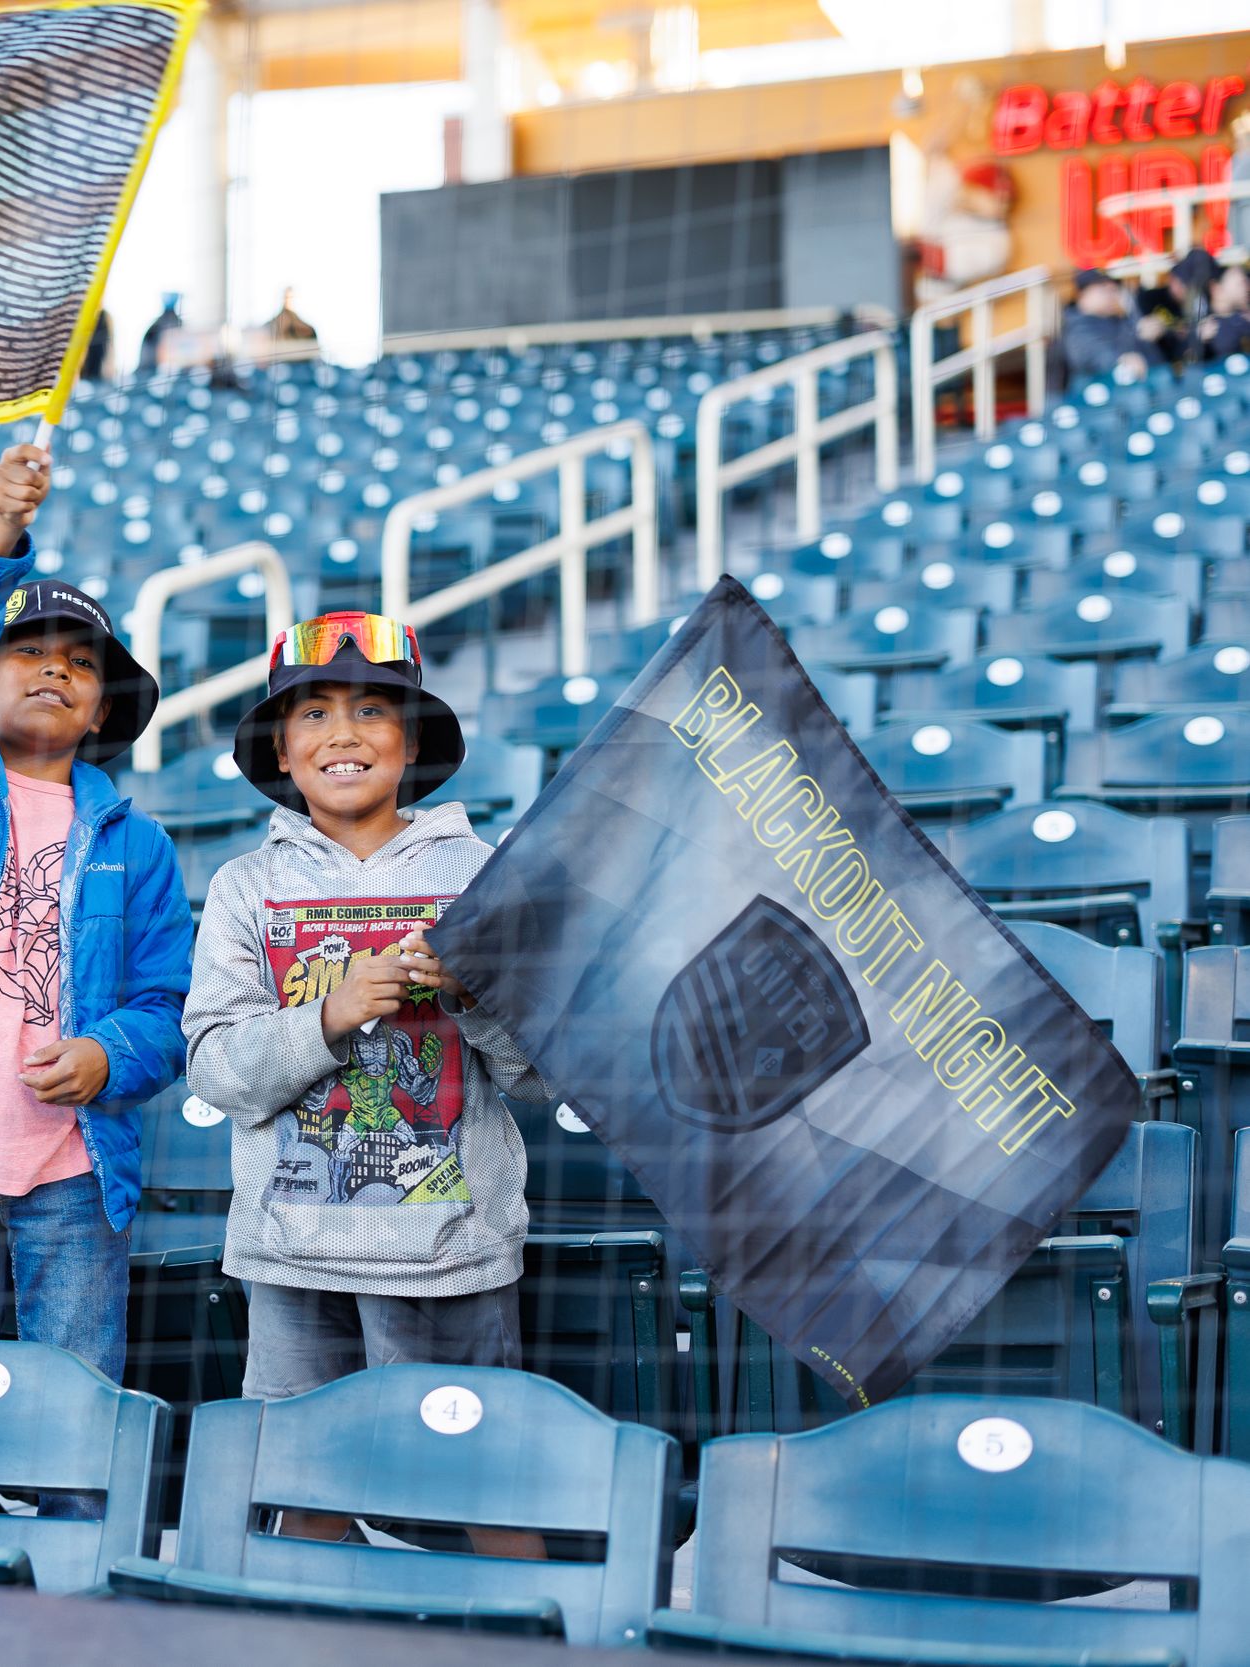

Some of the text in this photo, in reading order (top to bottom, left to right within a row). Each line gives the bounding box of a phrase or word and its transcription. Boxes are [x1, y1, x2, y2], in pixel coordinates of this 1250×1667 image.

[992, 75, 1245, 156] Batter
[90, 862, 125, 872] Columbi
[306, 908, 333, 920] RMN
[336, 907, 382, 919] COMICS
[386, 906, 426, 918] GROUP
[669, 665, 1077, 1156] BLACKOUT NIGHT
[323, 942, 345, 955] POW!
[740, 943, 829, 1053] UNITED
[759, 1053, 778, 1072] 18
[398, 1154, 435, 1176] BOOM!
[439, 1172, 463, 1195] EDITION
[811, 1346, 830, 1361] OCT
[442, 1399, 460, 1421] 4
[986, 1432, 1004, 1456] 5
